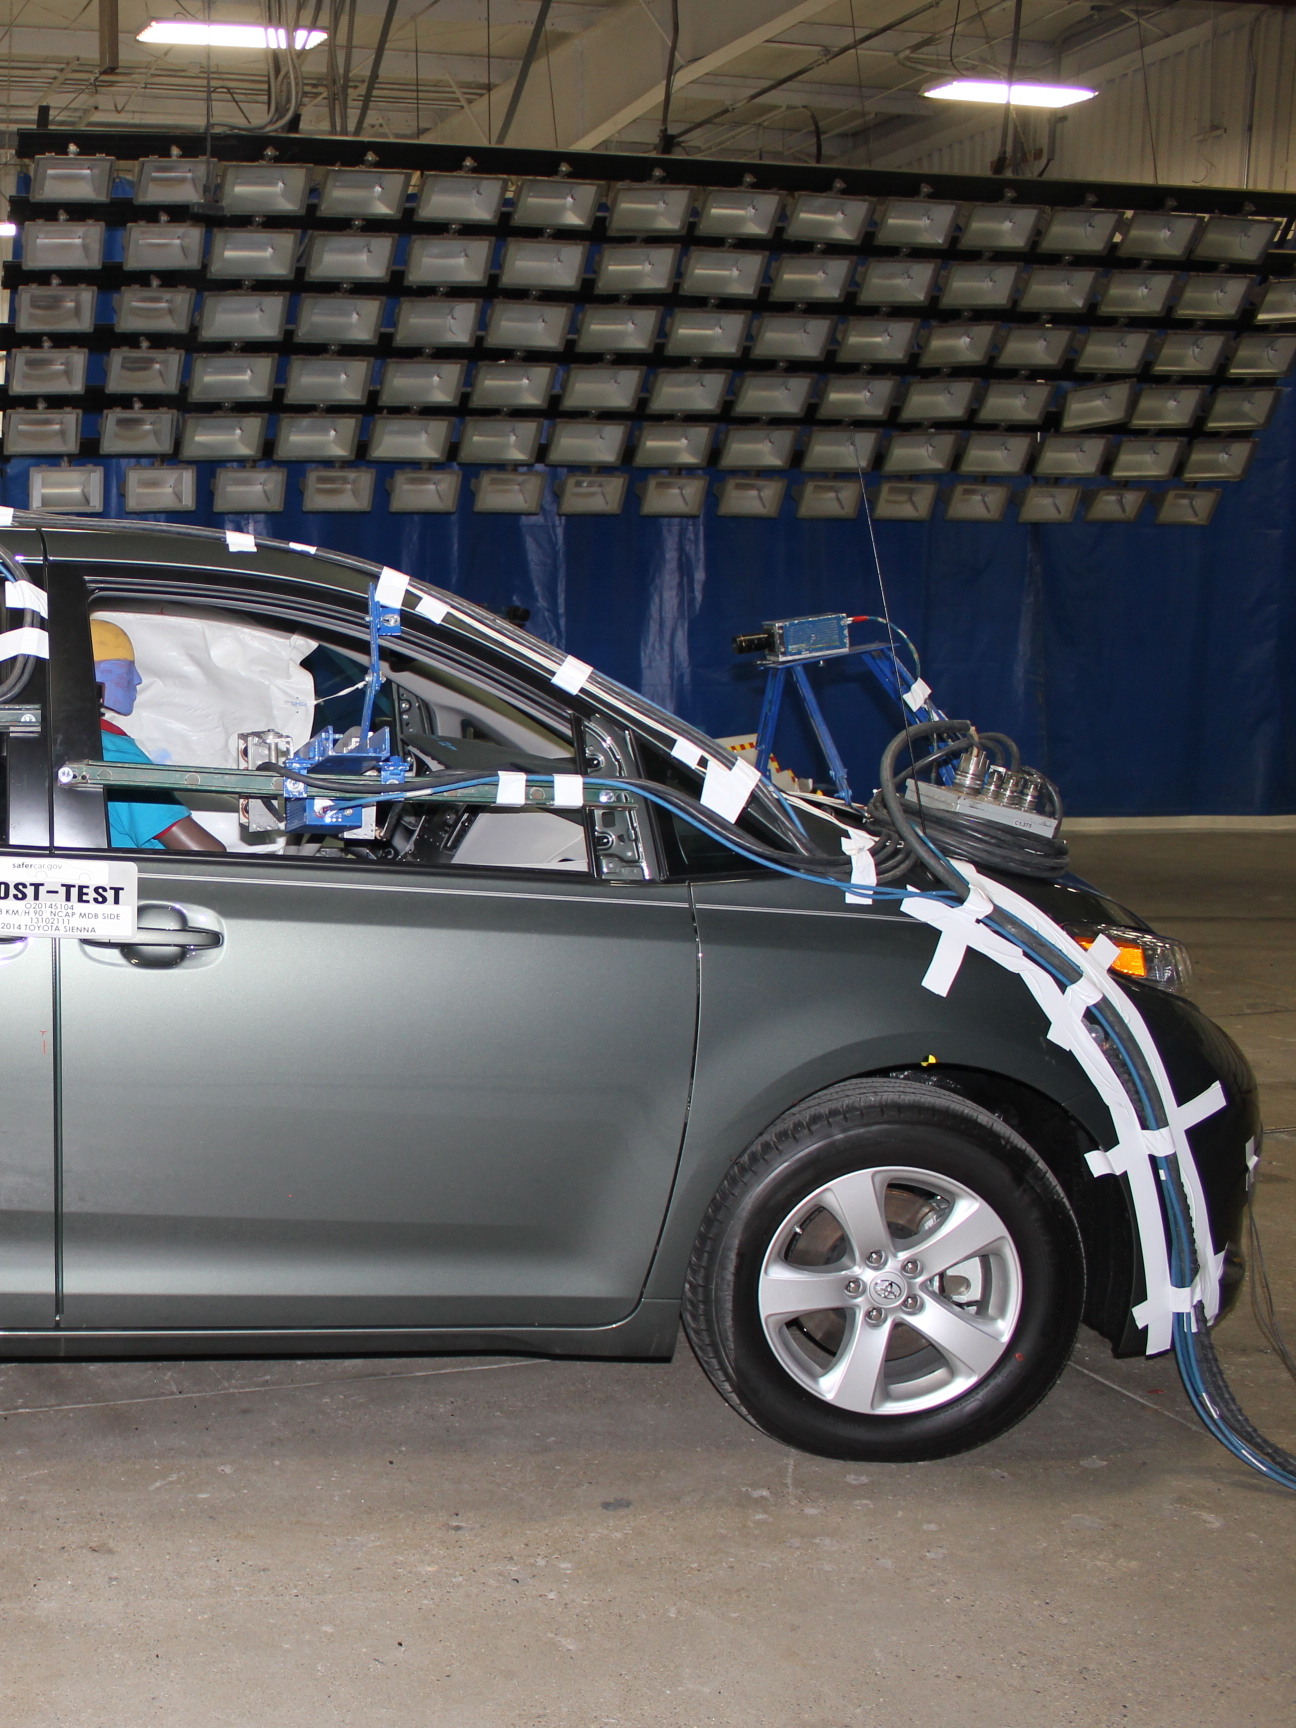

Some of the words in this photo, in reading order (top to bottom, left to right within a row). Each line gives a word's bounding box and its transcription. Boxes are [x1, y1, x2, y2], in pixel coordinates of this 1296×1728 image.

[12, 861, 63, 871] safercar.gov
[5, 909, 30, 917] KM/H
[50, 911, 76, 919] NCAP
[78, 912, 99, 920] MDB
[101, 913, 121, 921] SIDE
[30, 917, 70, 925] 13102111
[0, 922, 22, 931] 2014
[24, 924, 60, 933] TOYOTA
[63, 926, 97, 934] SIENNA
